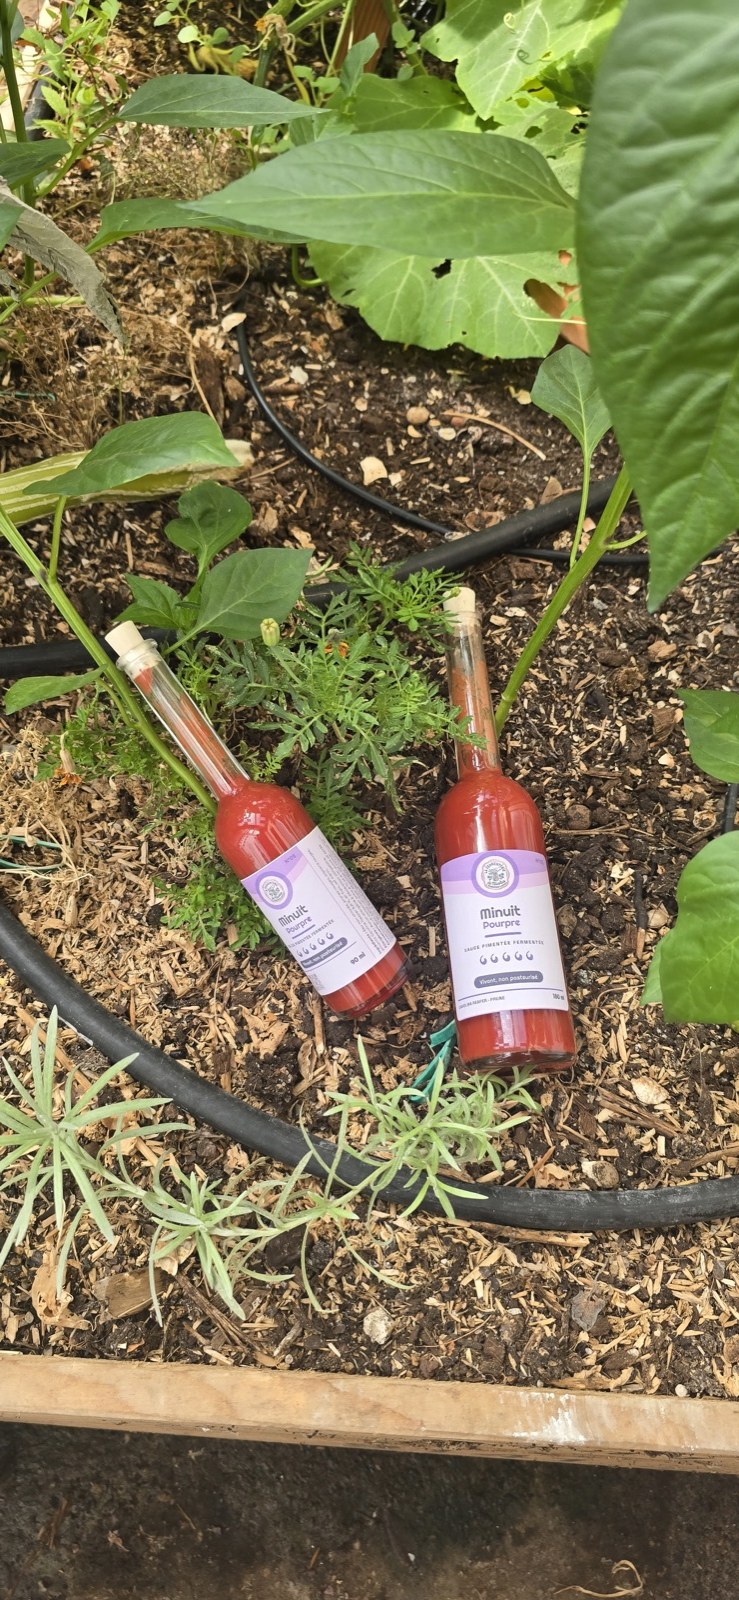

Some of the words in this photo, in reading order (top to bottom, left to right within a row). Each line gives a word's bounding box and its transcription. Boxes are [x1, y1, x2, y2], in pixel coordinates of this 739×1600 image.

[278, 904, 308, 927] Minuit
[480, 905, 521, 920] Minuit
[285, 916, 312, 934] Pourpre
[483, 919, 521, 930] Pourpre
[350, 956, 359, 965] 90
[359, 951, 366, 959] ml
